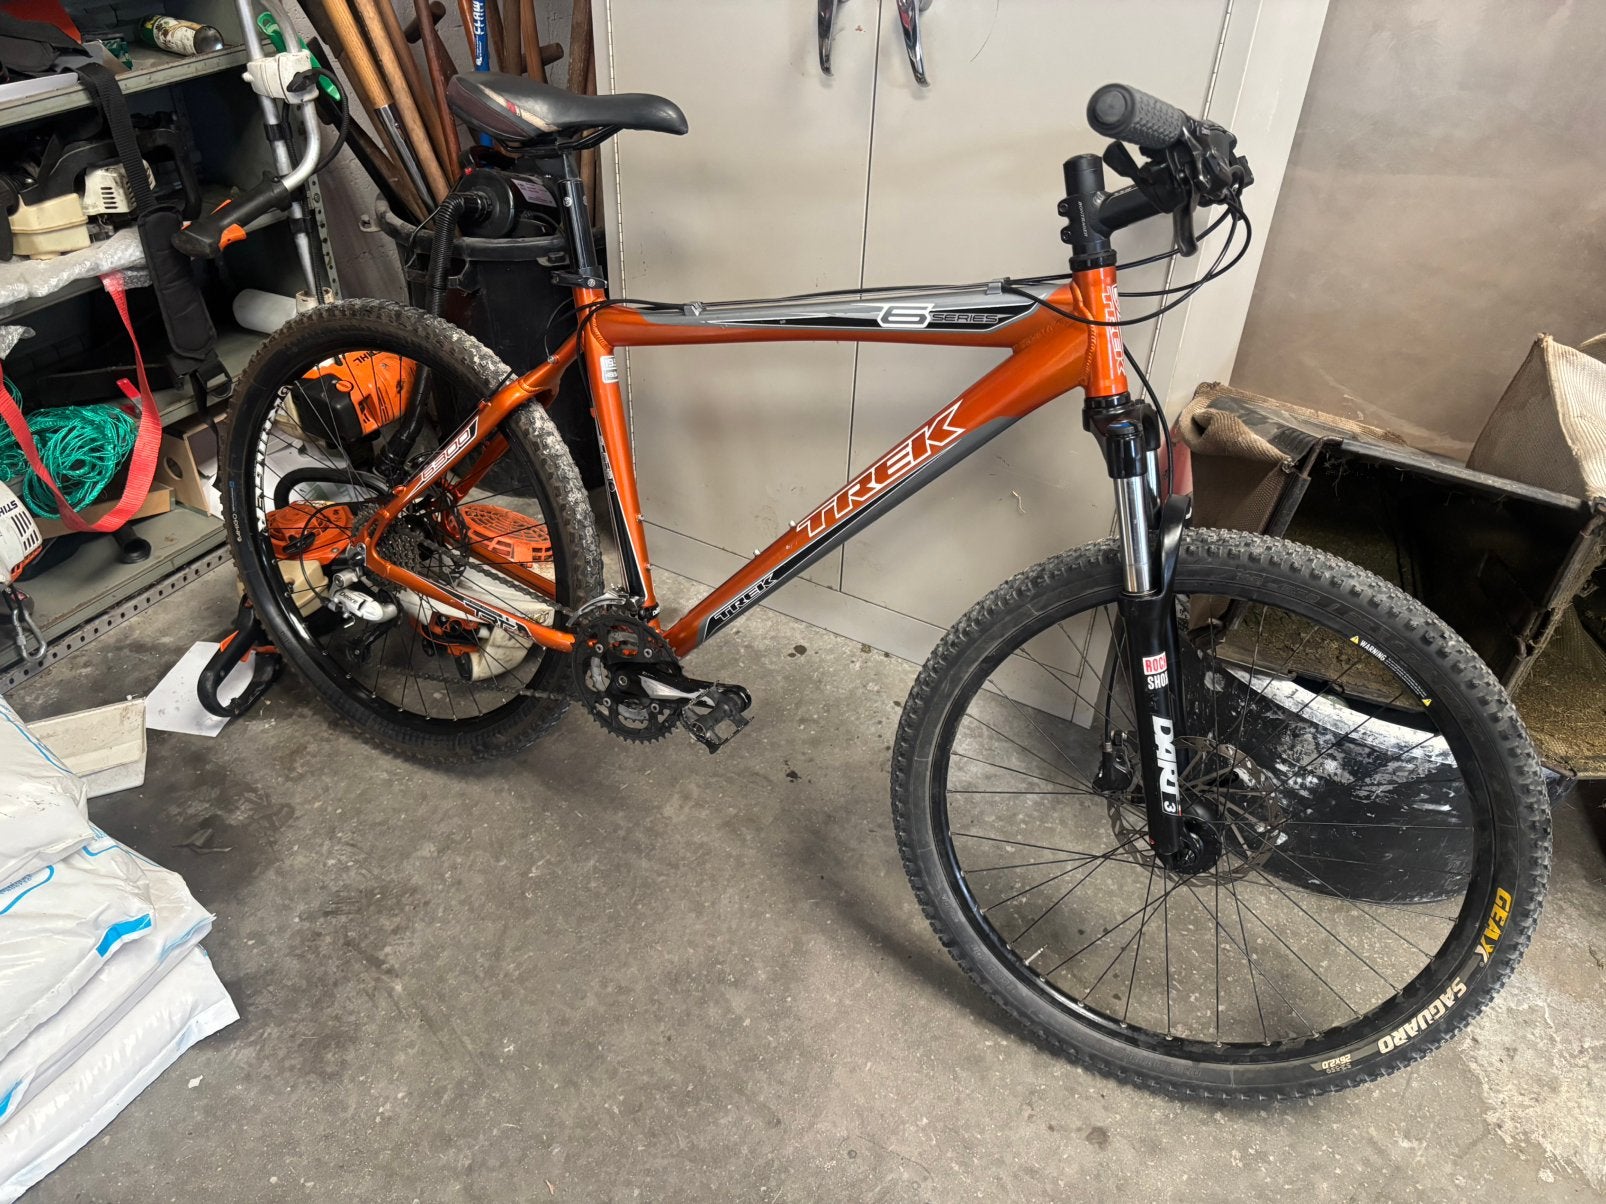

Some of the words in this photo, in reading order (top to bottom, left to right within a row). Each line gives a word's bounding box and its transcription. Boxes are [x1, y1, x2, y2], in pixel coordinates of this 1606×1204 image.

[879, 304, 934, 328] 6
[932, 313, 998, 323] SERIES
[796, 399, 967, 538] TREK
[714, 573, 778, 620] TREK
[1360, 640, 1387, 661] WARNING
[1152, 715, 1180, 798] DART
[1163, 800, 1177, 814] 3
[1474, 887, 1512, 963] GEAX
[1378, 977, 1467, 1054] SAGUARO
